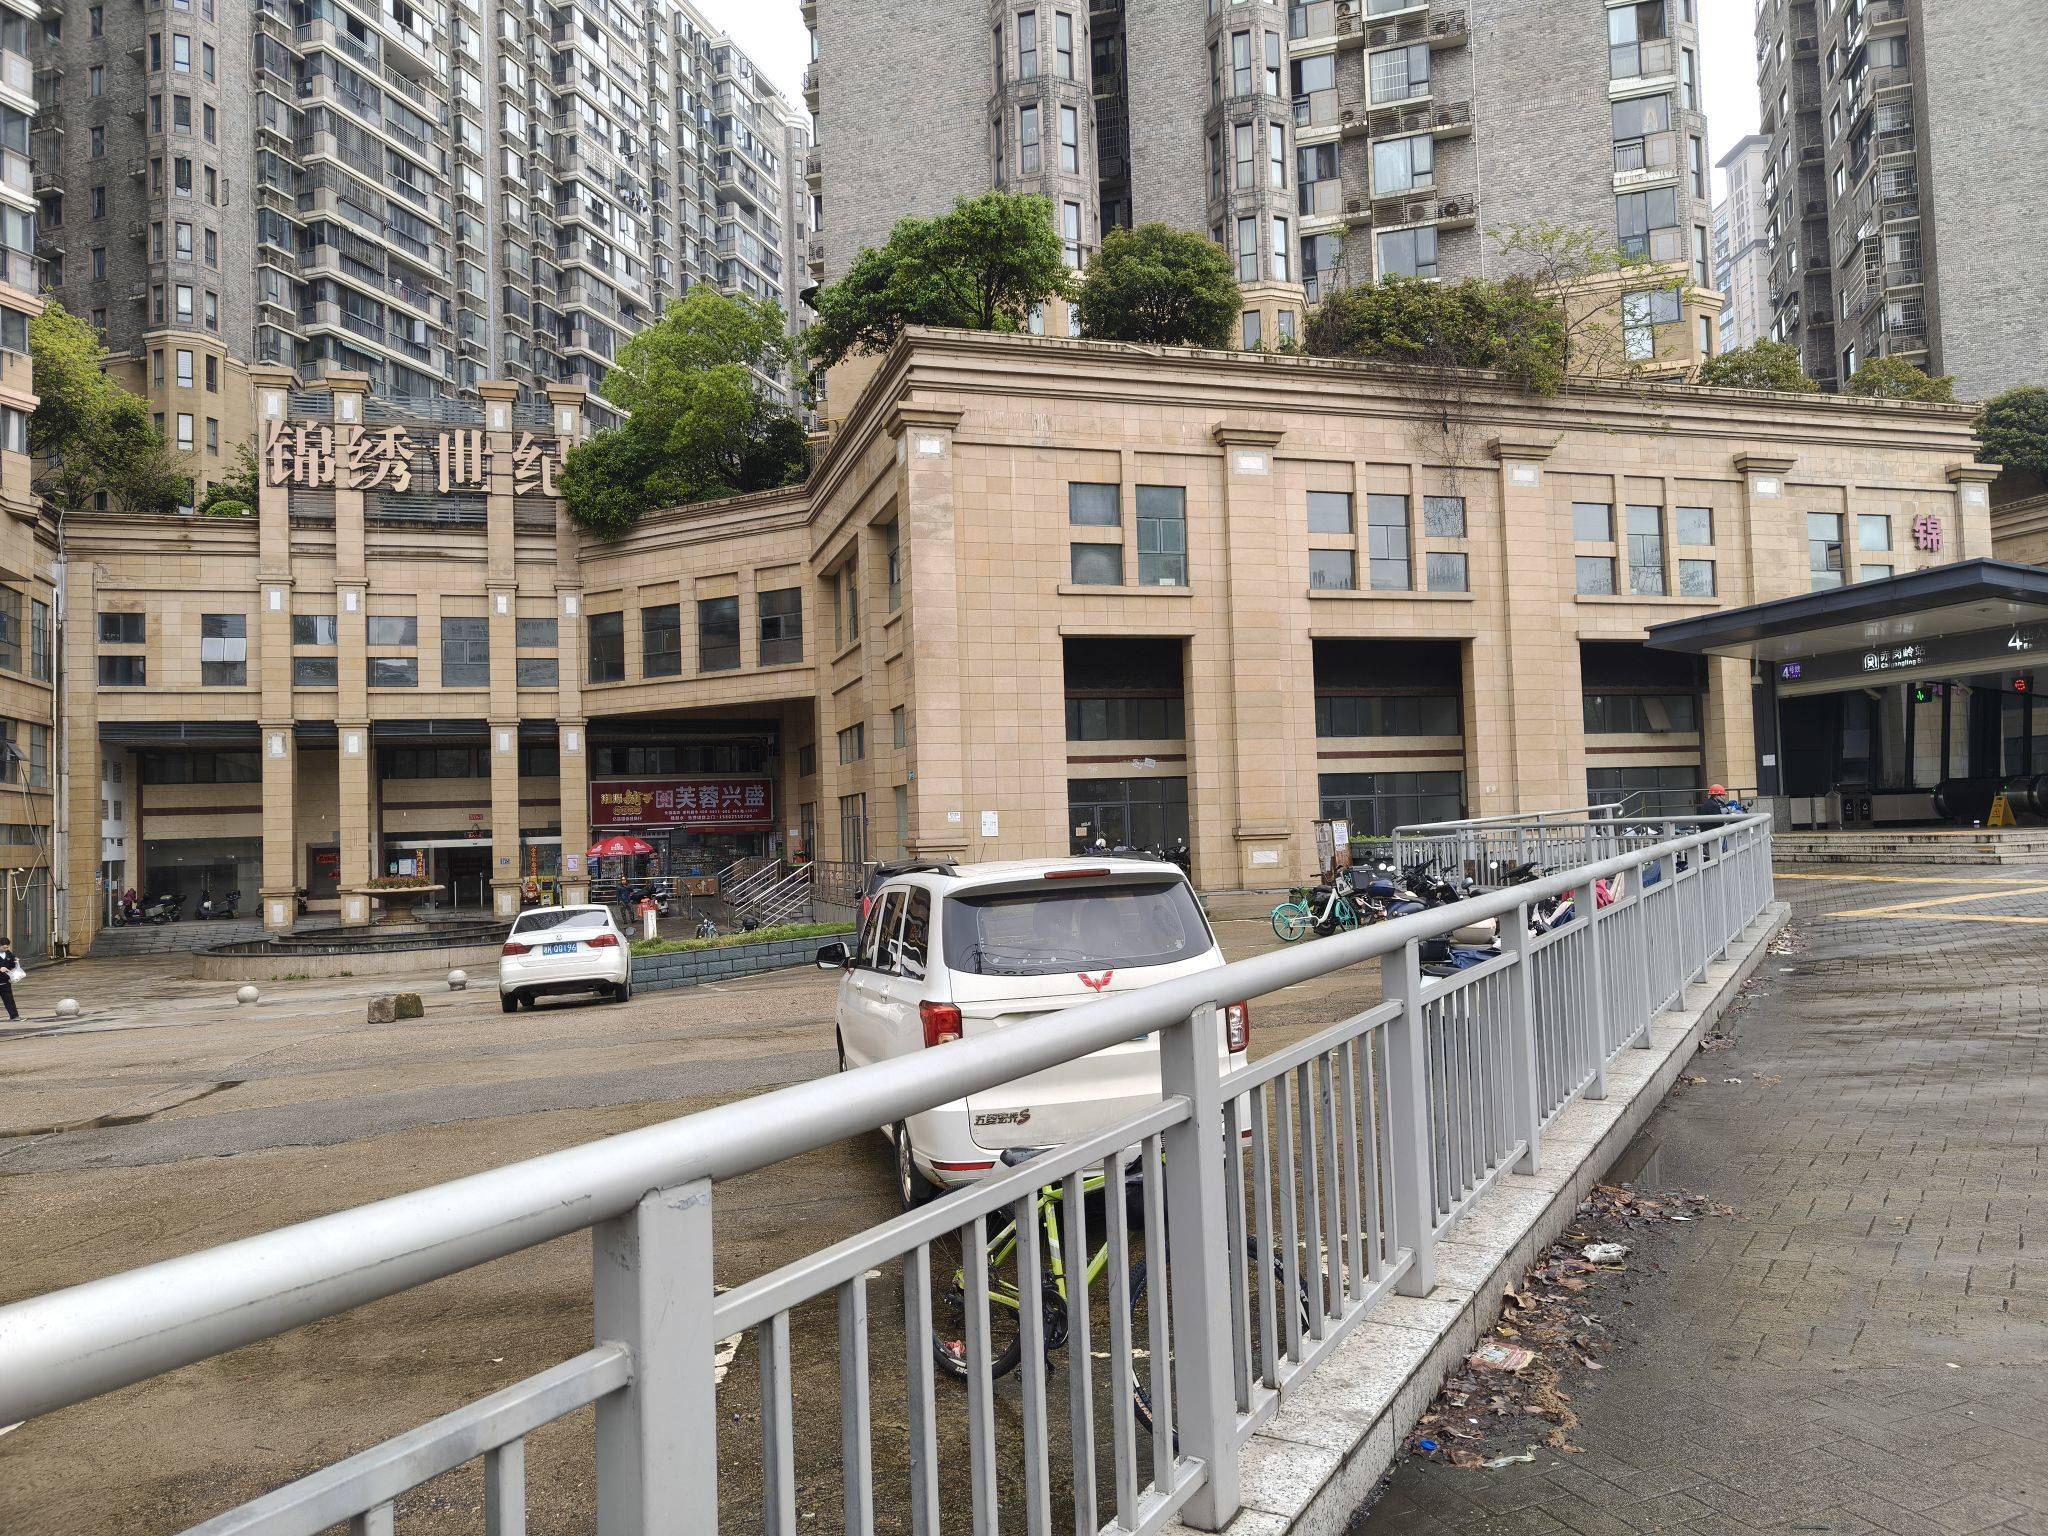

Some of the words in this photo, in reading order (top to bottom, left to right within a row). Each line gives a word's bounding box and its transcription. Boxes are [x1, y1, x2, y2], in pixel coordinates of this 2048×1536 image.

[265, 420, 573, 496] 锦绣世纪
[1911, 514, 1943, 552] 锦
[2007, 629, 2023, 650] 4
[676, 785, 764, 809] 芙蓉兴盛
